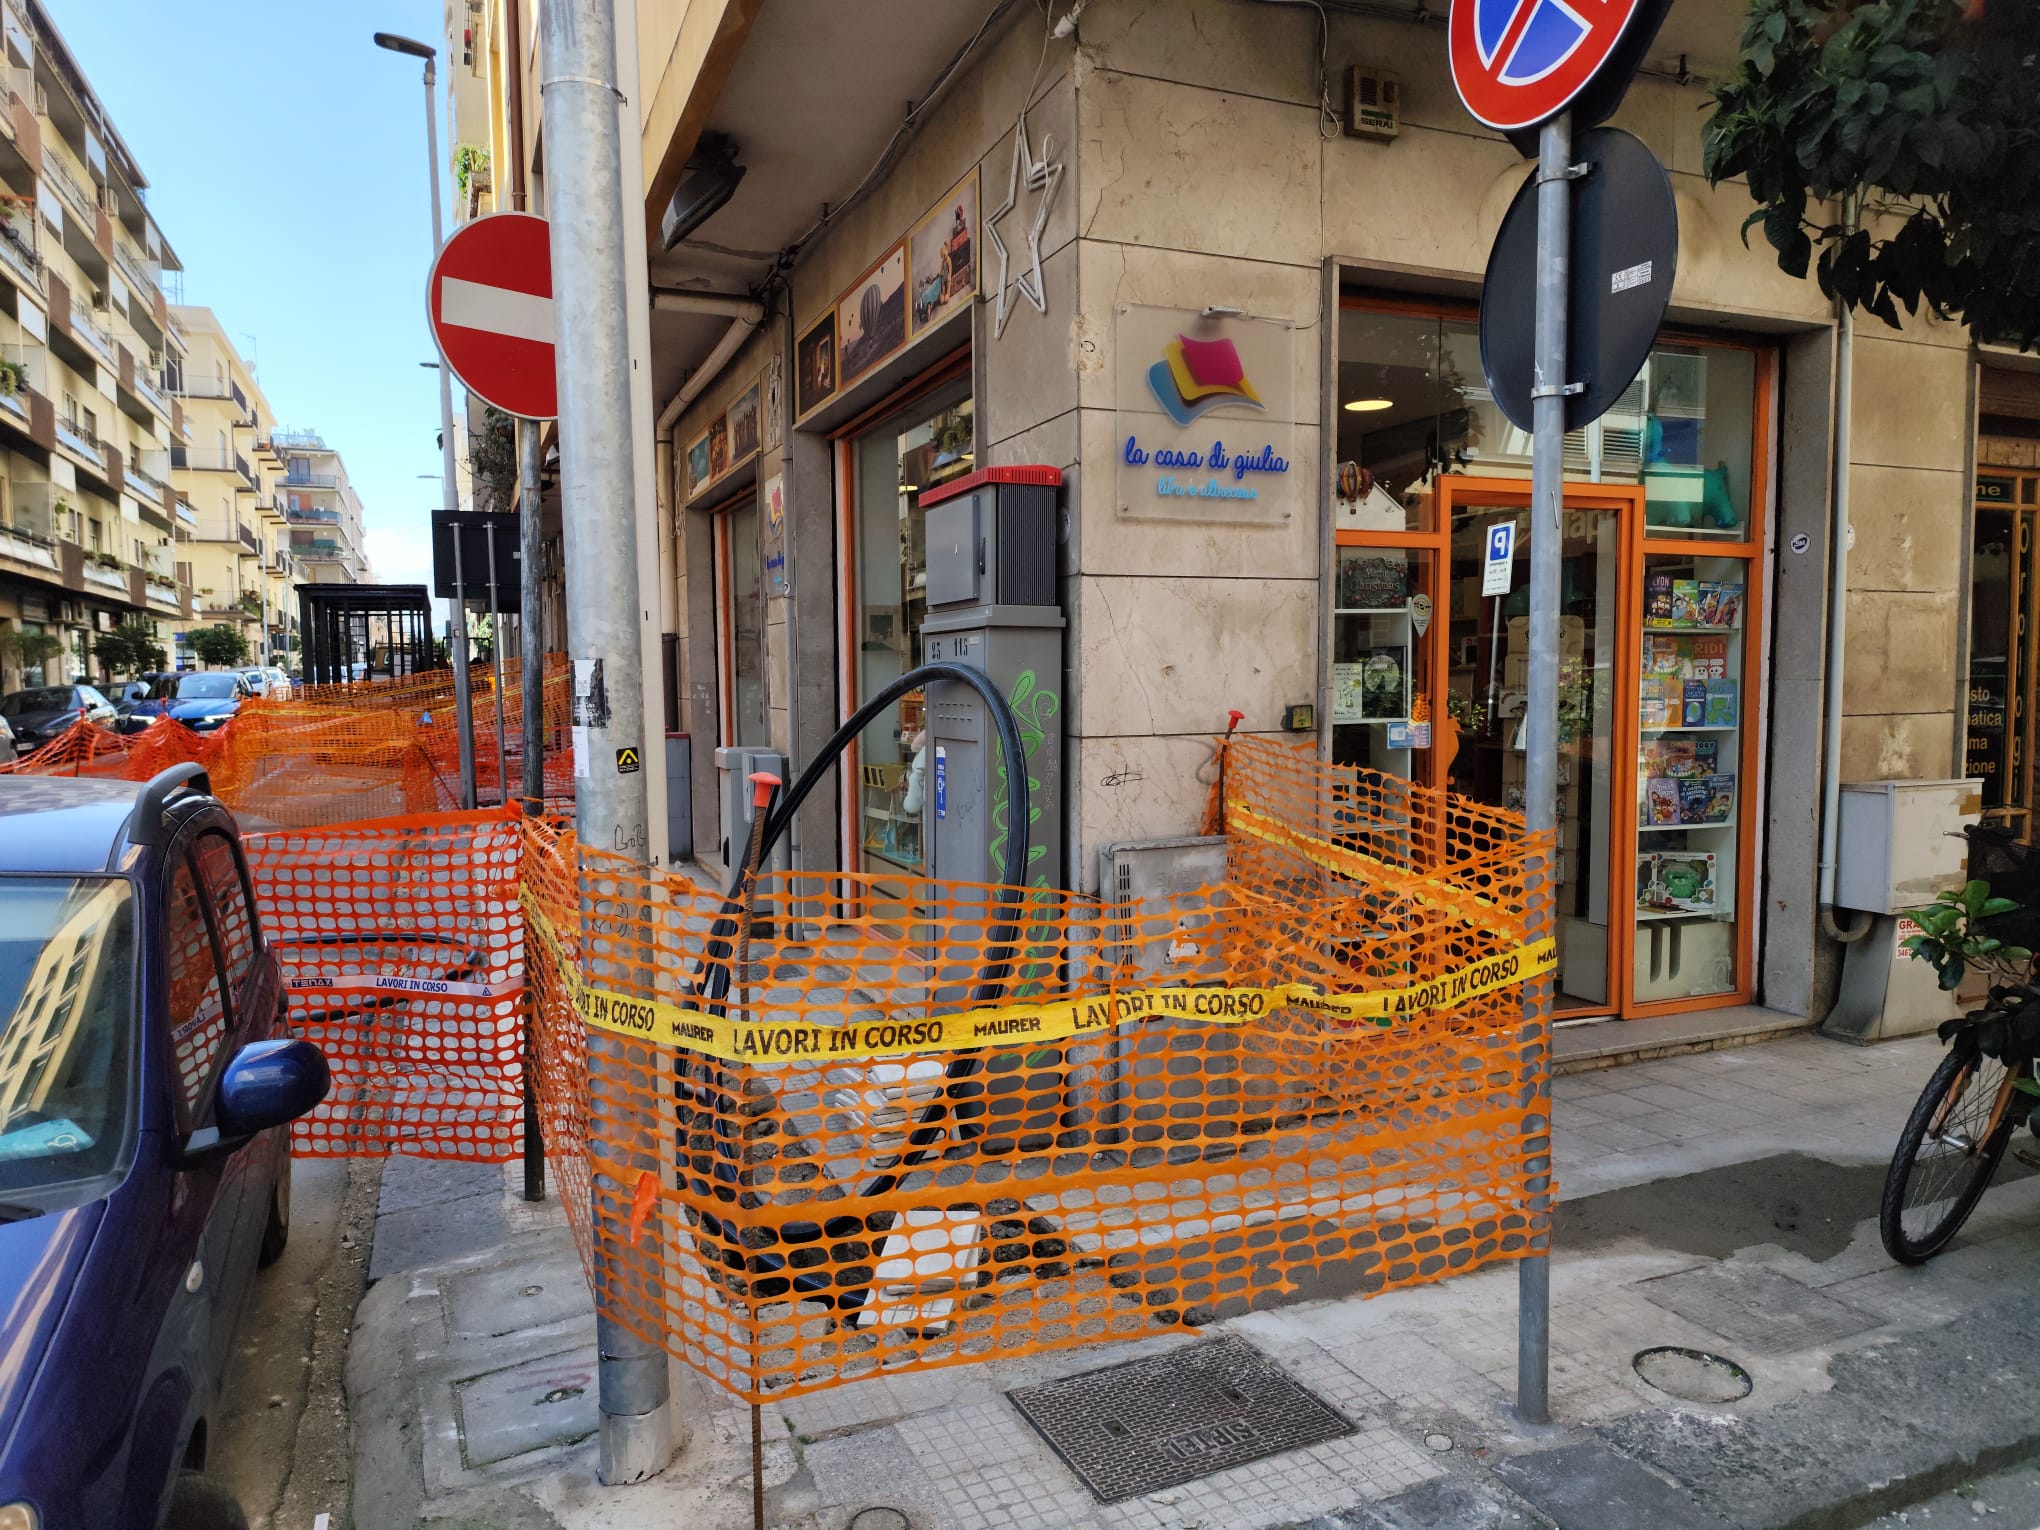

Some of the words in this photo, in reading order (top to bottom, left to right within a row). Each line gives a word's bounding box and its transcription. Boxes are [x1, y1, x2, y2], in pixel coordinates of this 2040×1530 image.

[1360, 117, 1393, 129] SERAI
[1125, 435, 1149, 465] la
[1155, 449, 1204, 469] casa
[1208, 440, 1230, 469] di
[1234, 444, 1289, 480] giulia
[1694, 642, 1723, 655] RIDI
[1969, 685, 1991, 702] sto
[376, 976, 408, 990] LAVORI
[410, 979, 421, 991] IN
[422, 981, 448, 993] CORSO
[593, 996, 609, 1022] IN
[611, 1000, 655, 1032] CORSO
[672, 1021, 714, 1043] MAURER
[733, 1027, 822, 1056] LAVORI
[829, 1028, 857, 1052] IN
[864, 1021, 944, 1049] CORSO
[974, 1017, 1042, 1037] MAURER
[1072, 994, 1155, 1031] LAVORI
[1161, 994, 1187, 1012] IN
[1193, 992, 1265, 1018] CORSO
[1451, 973, 1469, 999] IN
[1470, 955, 1520, 990] CORSO
[1536, 947, 1558, 966] MAU
